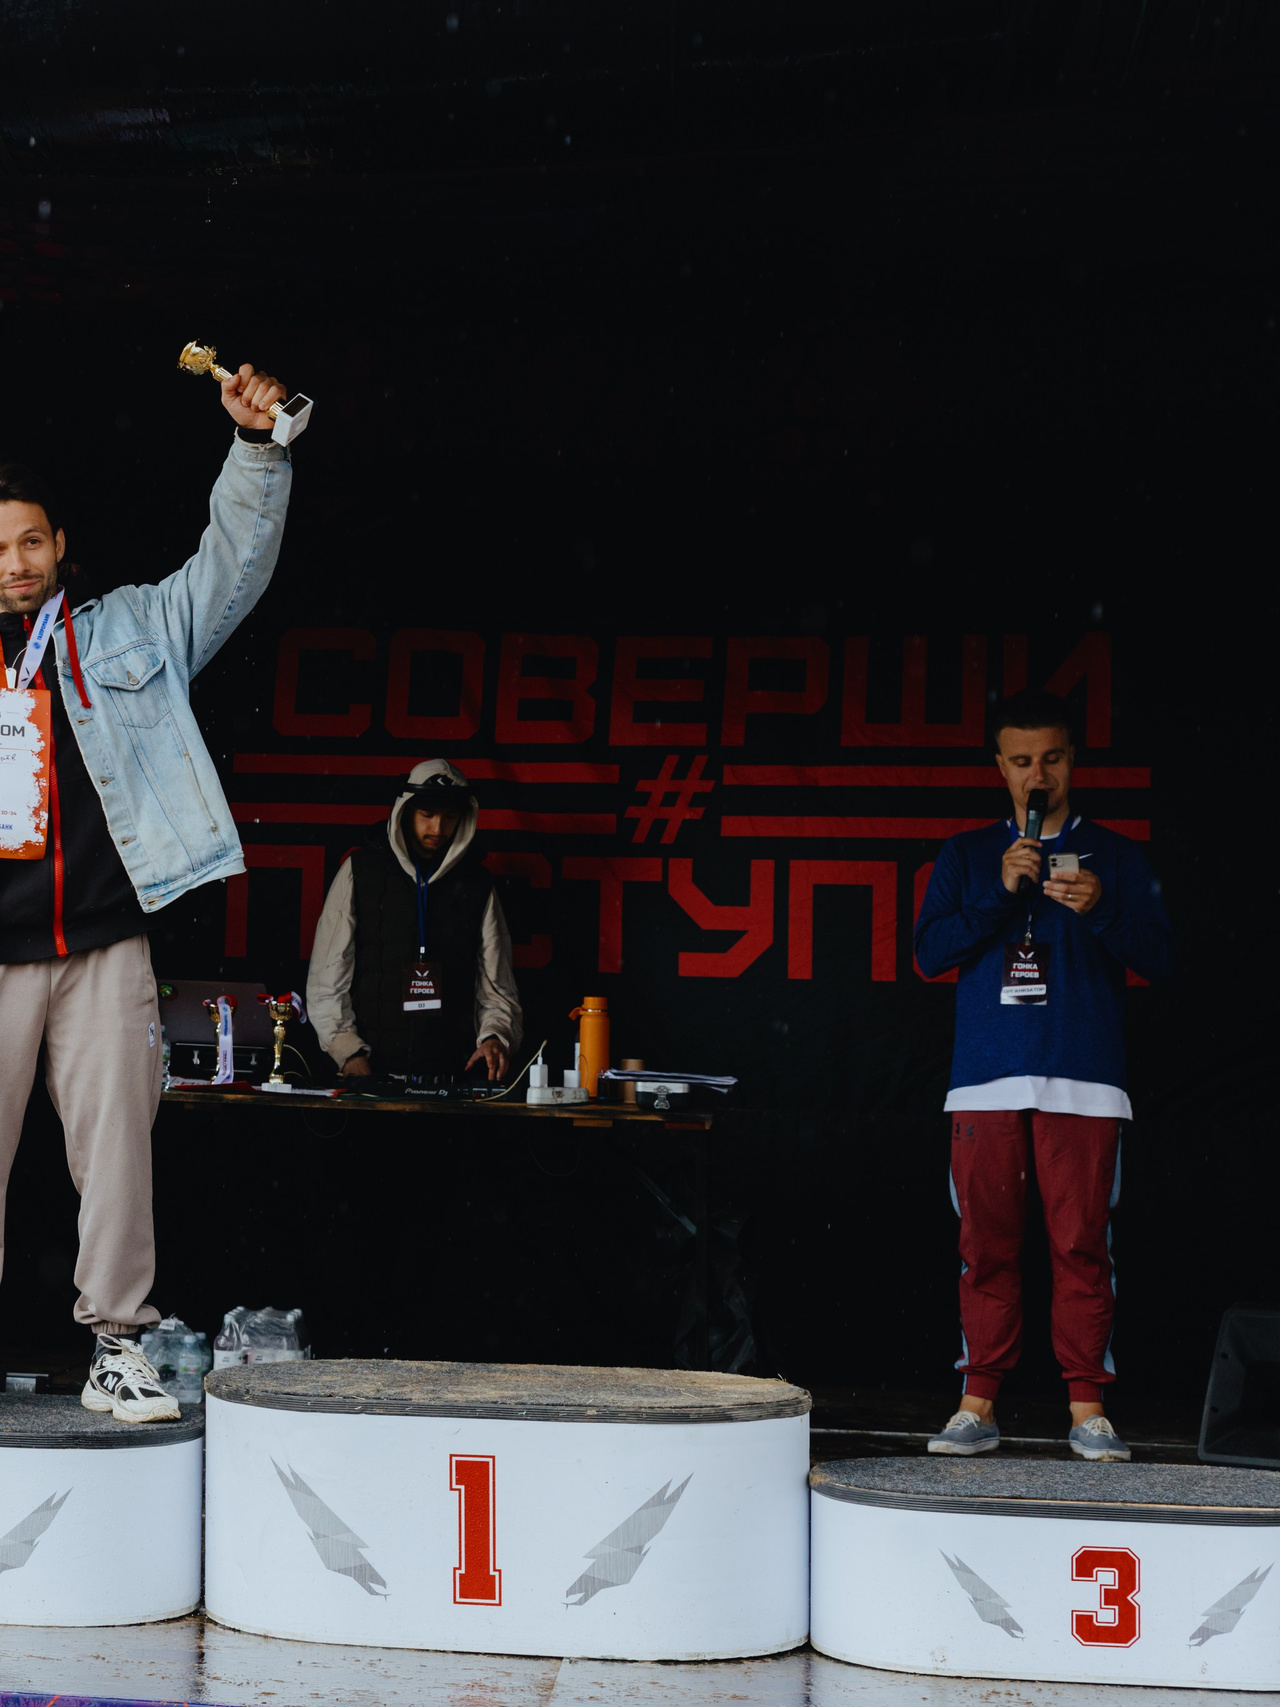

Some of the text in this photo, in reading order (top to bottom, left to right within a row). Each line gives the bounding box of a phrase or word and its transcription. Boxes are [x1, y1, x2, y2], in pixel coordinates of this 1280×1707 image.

[272, 627, 1112, 748] СОВЕРШИ
[102, 1373, 119, 1391] N
[450, 1454, 501, 1606] 1
[1071, 1546, 1140, 1648] 3
